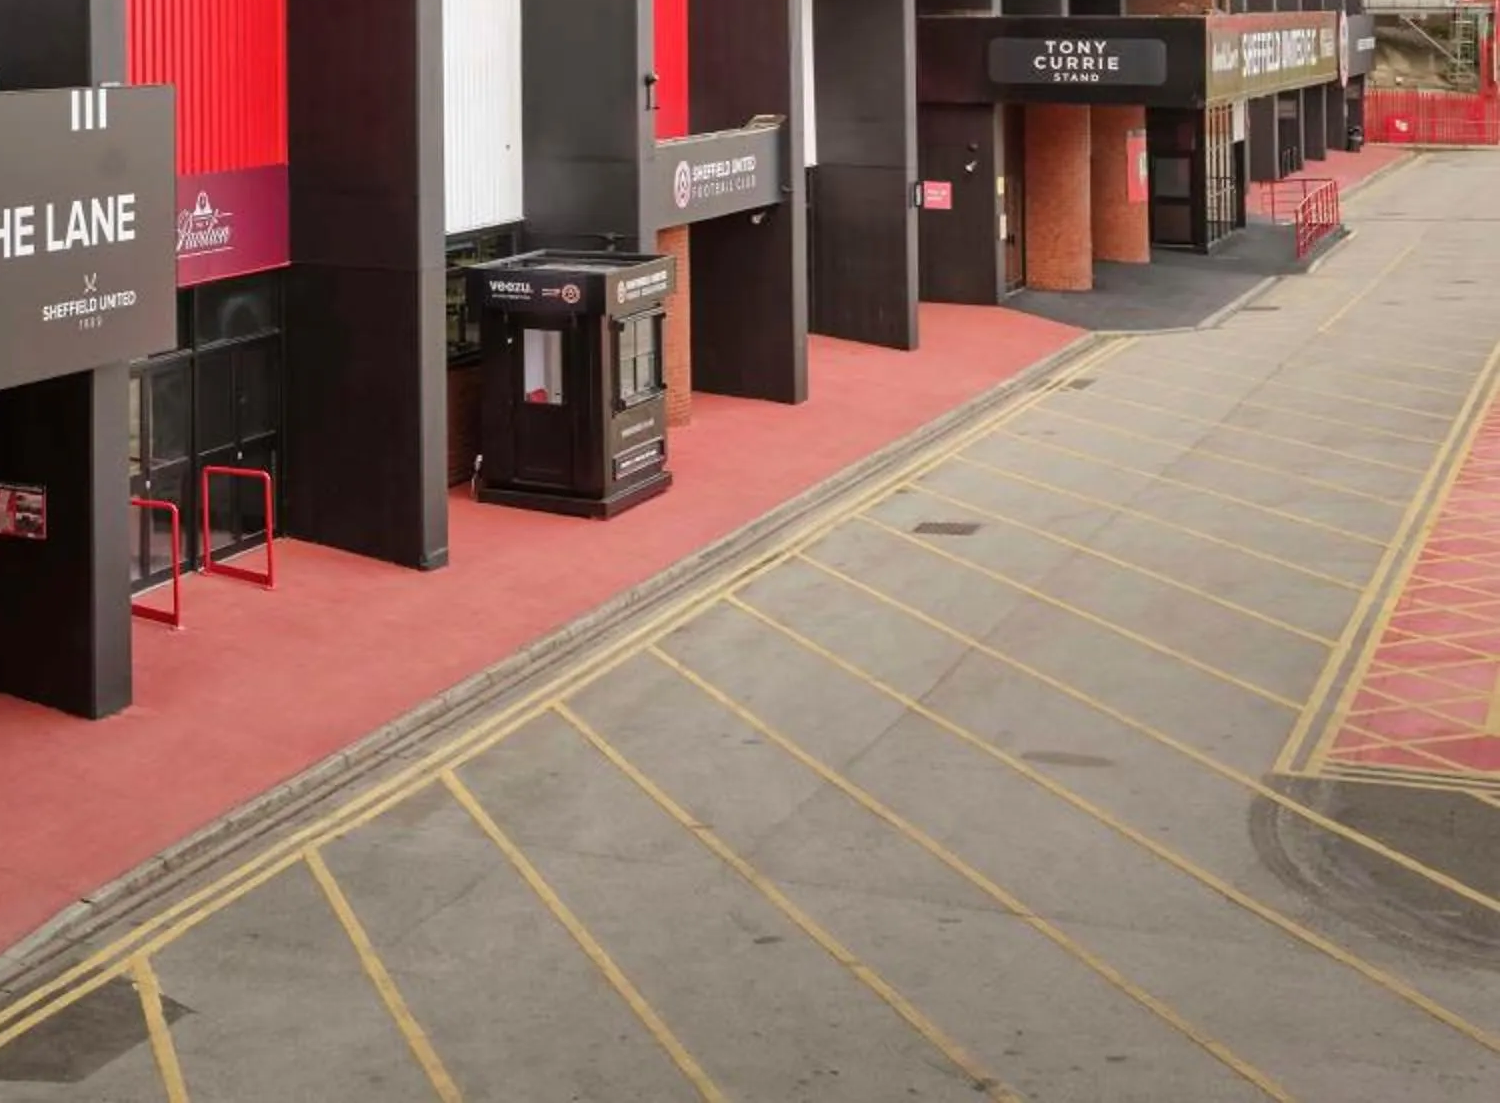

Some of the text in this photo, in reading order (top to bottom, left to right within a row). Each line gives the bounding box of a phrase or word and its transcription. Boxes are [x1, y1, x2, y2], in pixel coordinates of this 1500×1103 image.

[1045, 40, 1107, 54] TONY
[1033, 56, 1120, 70] CURRIE
[1053, 73, 1099, 82] STAND
[692, 161, 730, 181] SHEFFIELD
[46, 194, 136, 252] LANE
[43, 290, 137, 321] SHEFFIELD UNITED
